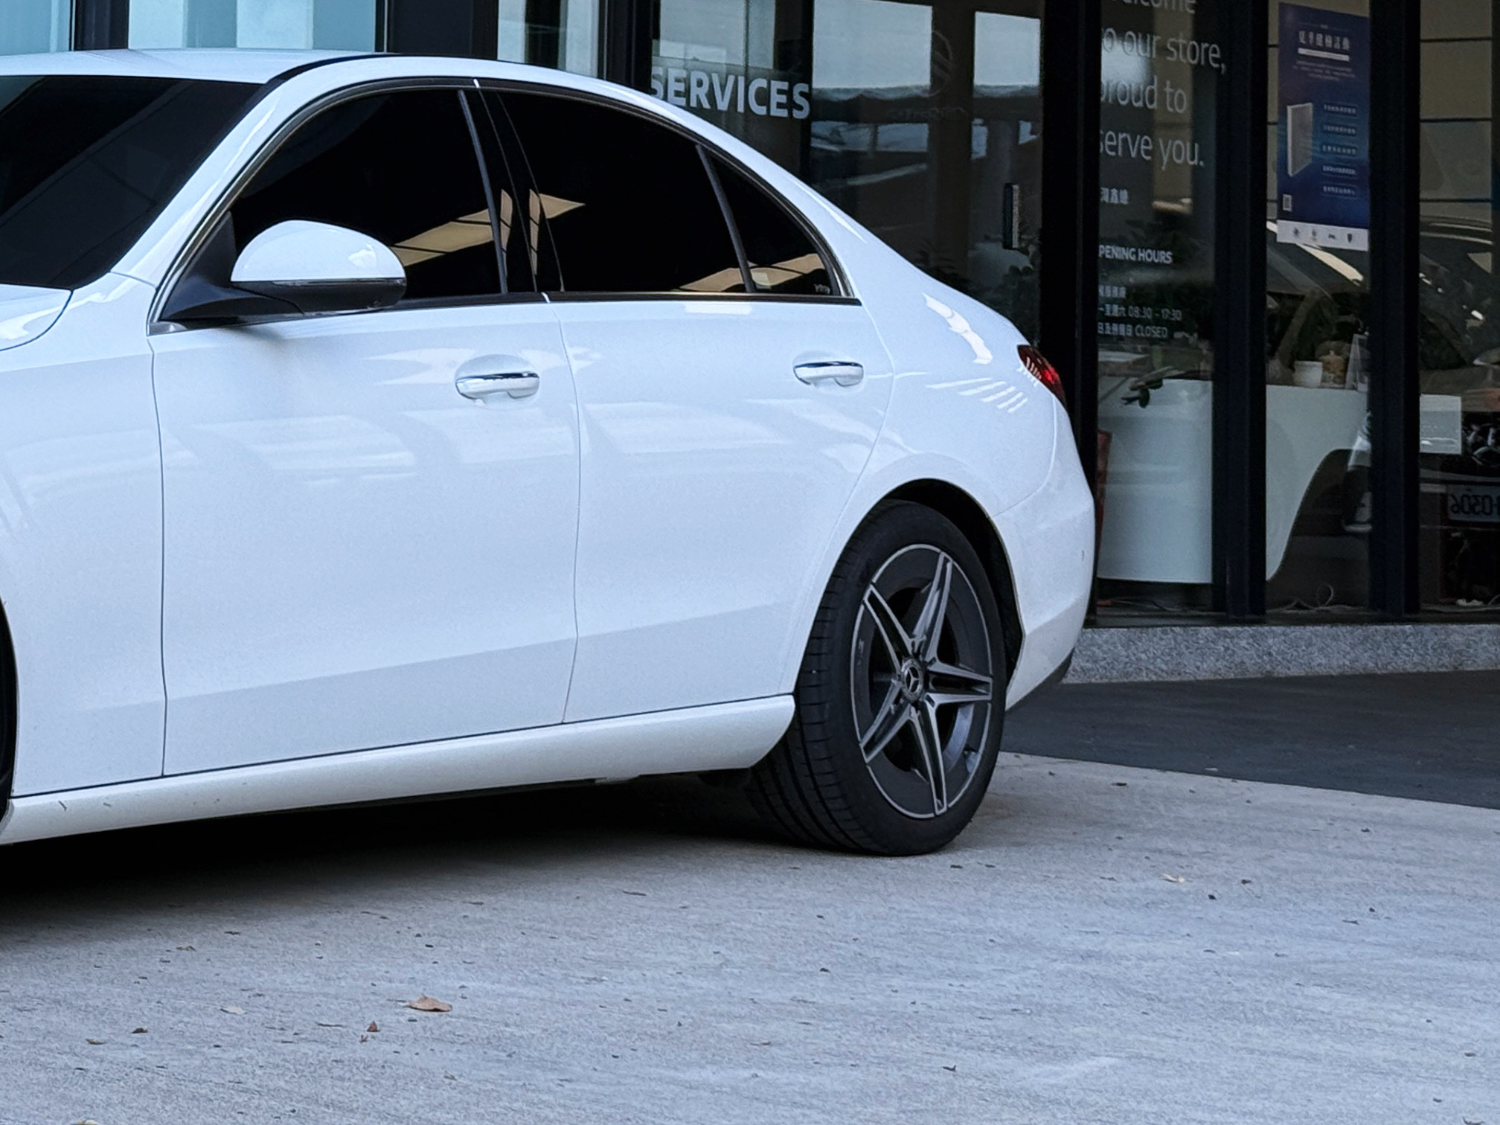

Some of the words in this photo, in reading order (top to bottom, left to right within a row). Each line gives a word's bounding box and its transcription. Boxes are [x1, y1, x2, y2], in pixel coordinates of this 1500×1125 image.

[1101, 27, 1117, 54] o
[1122, 31, 1162, 59] our
[1166, 36, 1227, 75] store,
[650, 65, 811, 120] SERVICES
[1164, 79, 1188, 114] to
[1158, 137, 1205, 172] you.
[1098, 244, 1137, 262] PENING
[1138, 247, 1173, 265] HOURS
[1134, 323, 1169, 339] CLOSED
